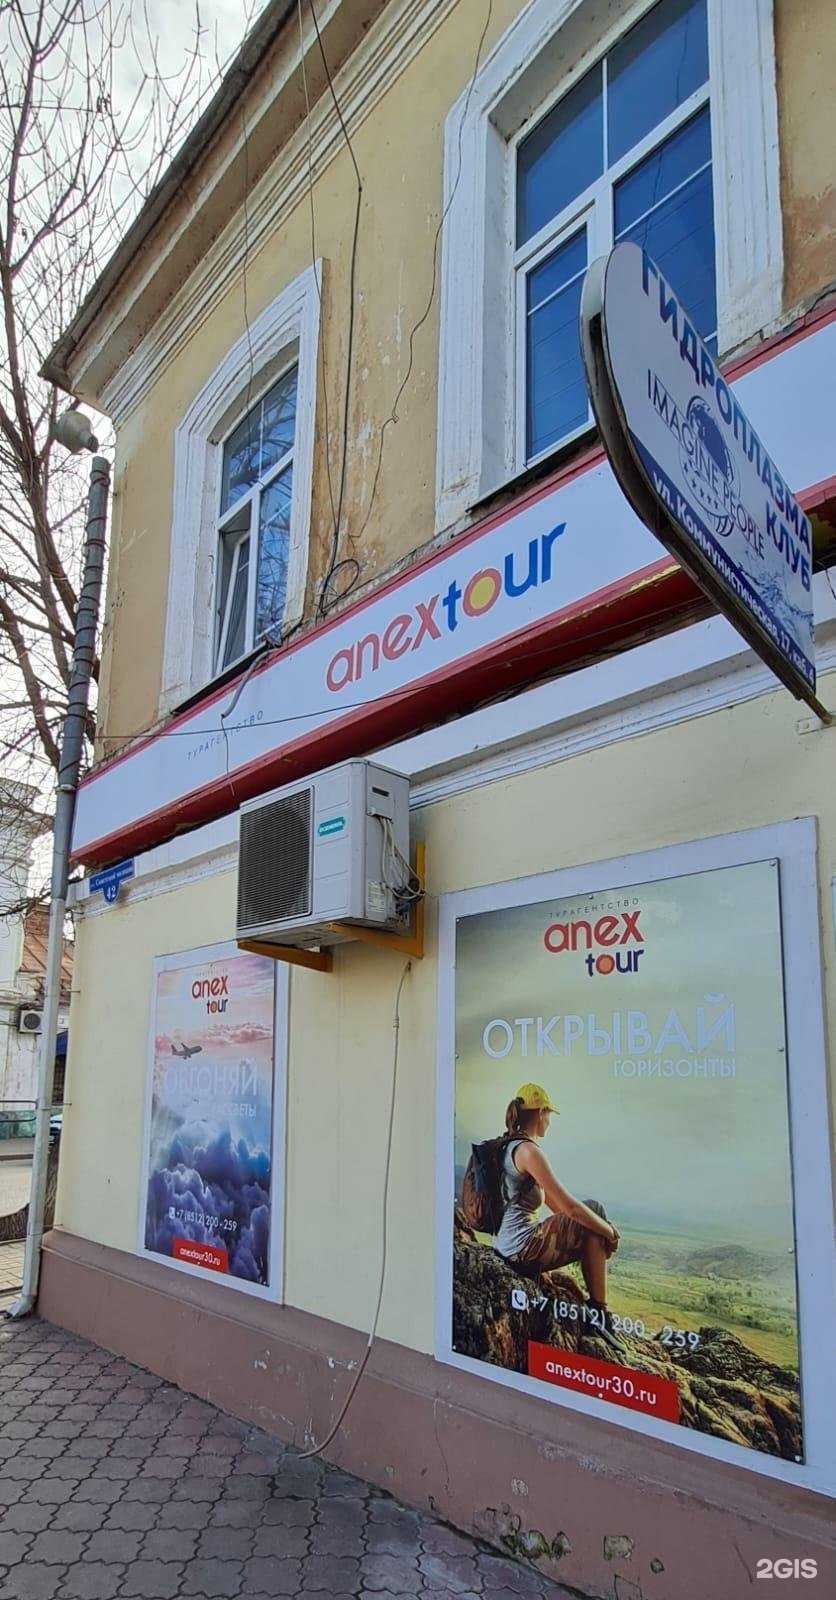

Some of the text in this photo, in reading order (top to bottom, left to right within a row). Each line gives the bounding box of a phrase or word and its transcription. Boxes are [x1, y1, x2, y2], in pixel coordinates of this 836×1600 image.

[641, 249, 810, 550] ГИДРОПЛАЗМА
[648, 368, 764, 561] IMAGINE PEOPLE
[653, 472, 672, 505] ул.
[766, 500, 811, 592] КЛУБ
[106, 885, 116, 900] 42
[550, 897, 640, 919] ТУРАГЕНТСТВО
[544, 910, 644, 953] anex
[585, 949, 645, 977] tour
[192, 975, 228, 999] anex
[207, 998, 228, 1014] tour
[482, 992, 736, 1059] ОТКРЫВАЙ
[614, 1058, 736, 1078] ГОРИЗОНТЫ
[206, 1215, 219, 1228] 200
[224, 1219, 238, 1232] 259
[531, 1296, 548, 1312] +7
[553, 1298, 606, 1331] (8512)
[612, 1313, 645, 1337] 200
[661, 1326, 700, 1350] 259
[545, 1359, 657, 1405] anextour30.ru
